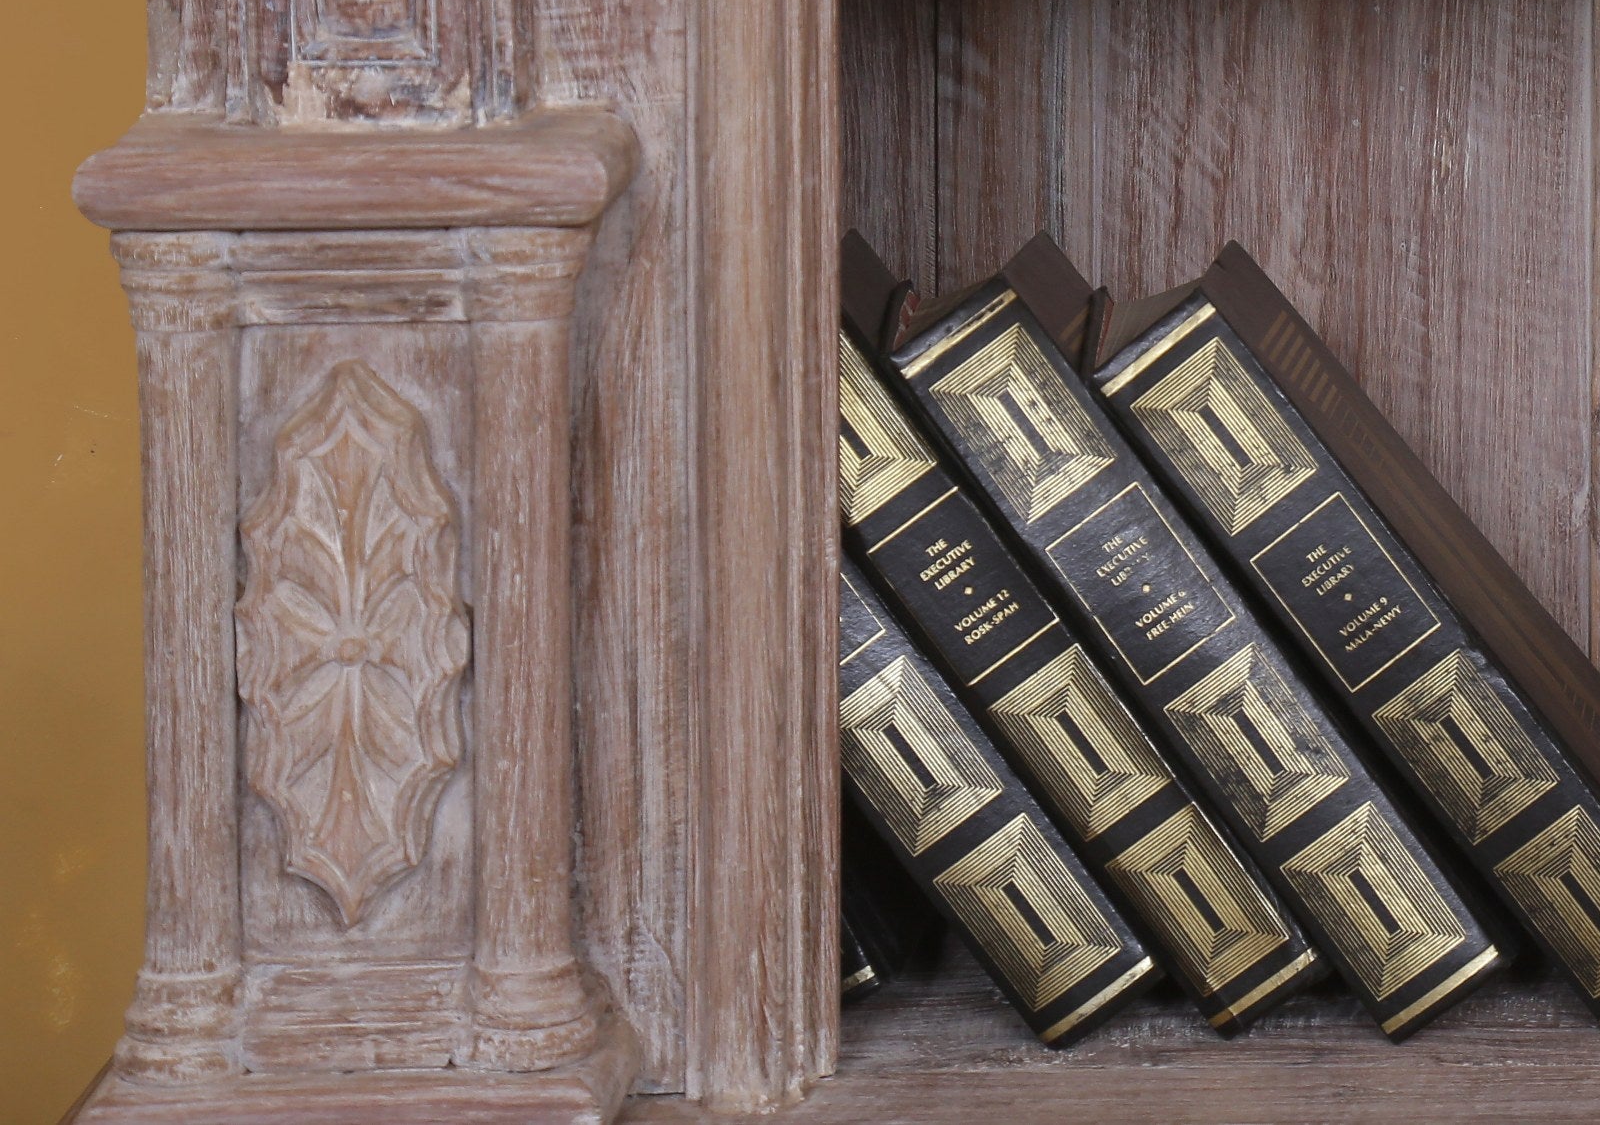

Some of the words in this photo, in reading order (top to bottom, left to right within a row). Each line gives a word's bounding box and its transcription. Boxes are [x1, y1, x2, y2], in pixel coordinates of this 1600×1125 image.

[919, 539, 973, 582] EXECUTIVE
[925, 538, 949, 557] THE
[1096, 536, 1148, 577] EXECUTIVE
[1102, 535, 1124, 553] THE
[1305, 544, 1328, 563] THE
[934, 556, 976, 590] LIBRARY
[1301, 545, 1352, 588] EXECUTIVE
[1316, 564, 1355, 596] LIBRARY
[954, 597, 998, 632] VOLUME
[996, 589, 1010, 601] 12
[964, 602, 1019, 645] ROSK-SPAH
[1135, 593, 1178, 628] VOLUME
[1145, 601, 1195, 641] FREE-HEIN
[1339, 602, 1381, 637] VOLUME
[1379, 596, 1388, 606] 9
[1345, 604, 1402, 652] MALA-NEWY
